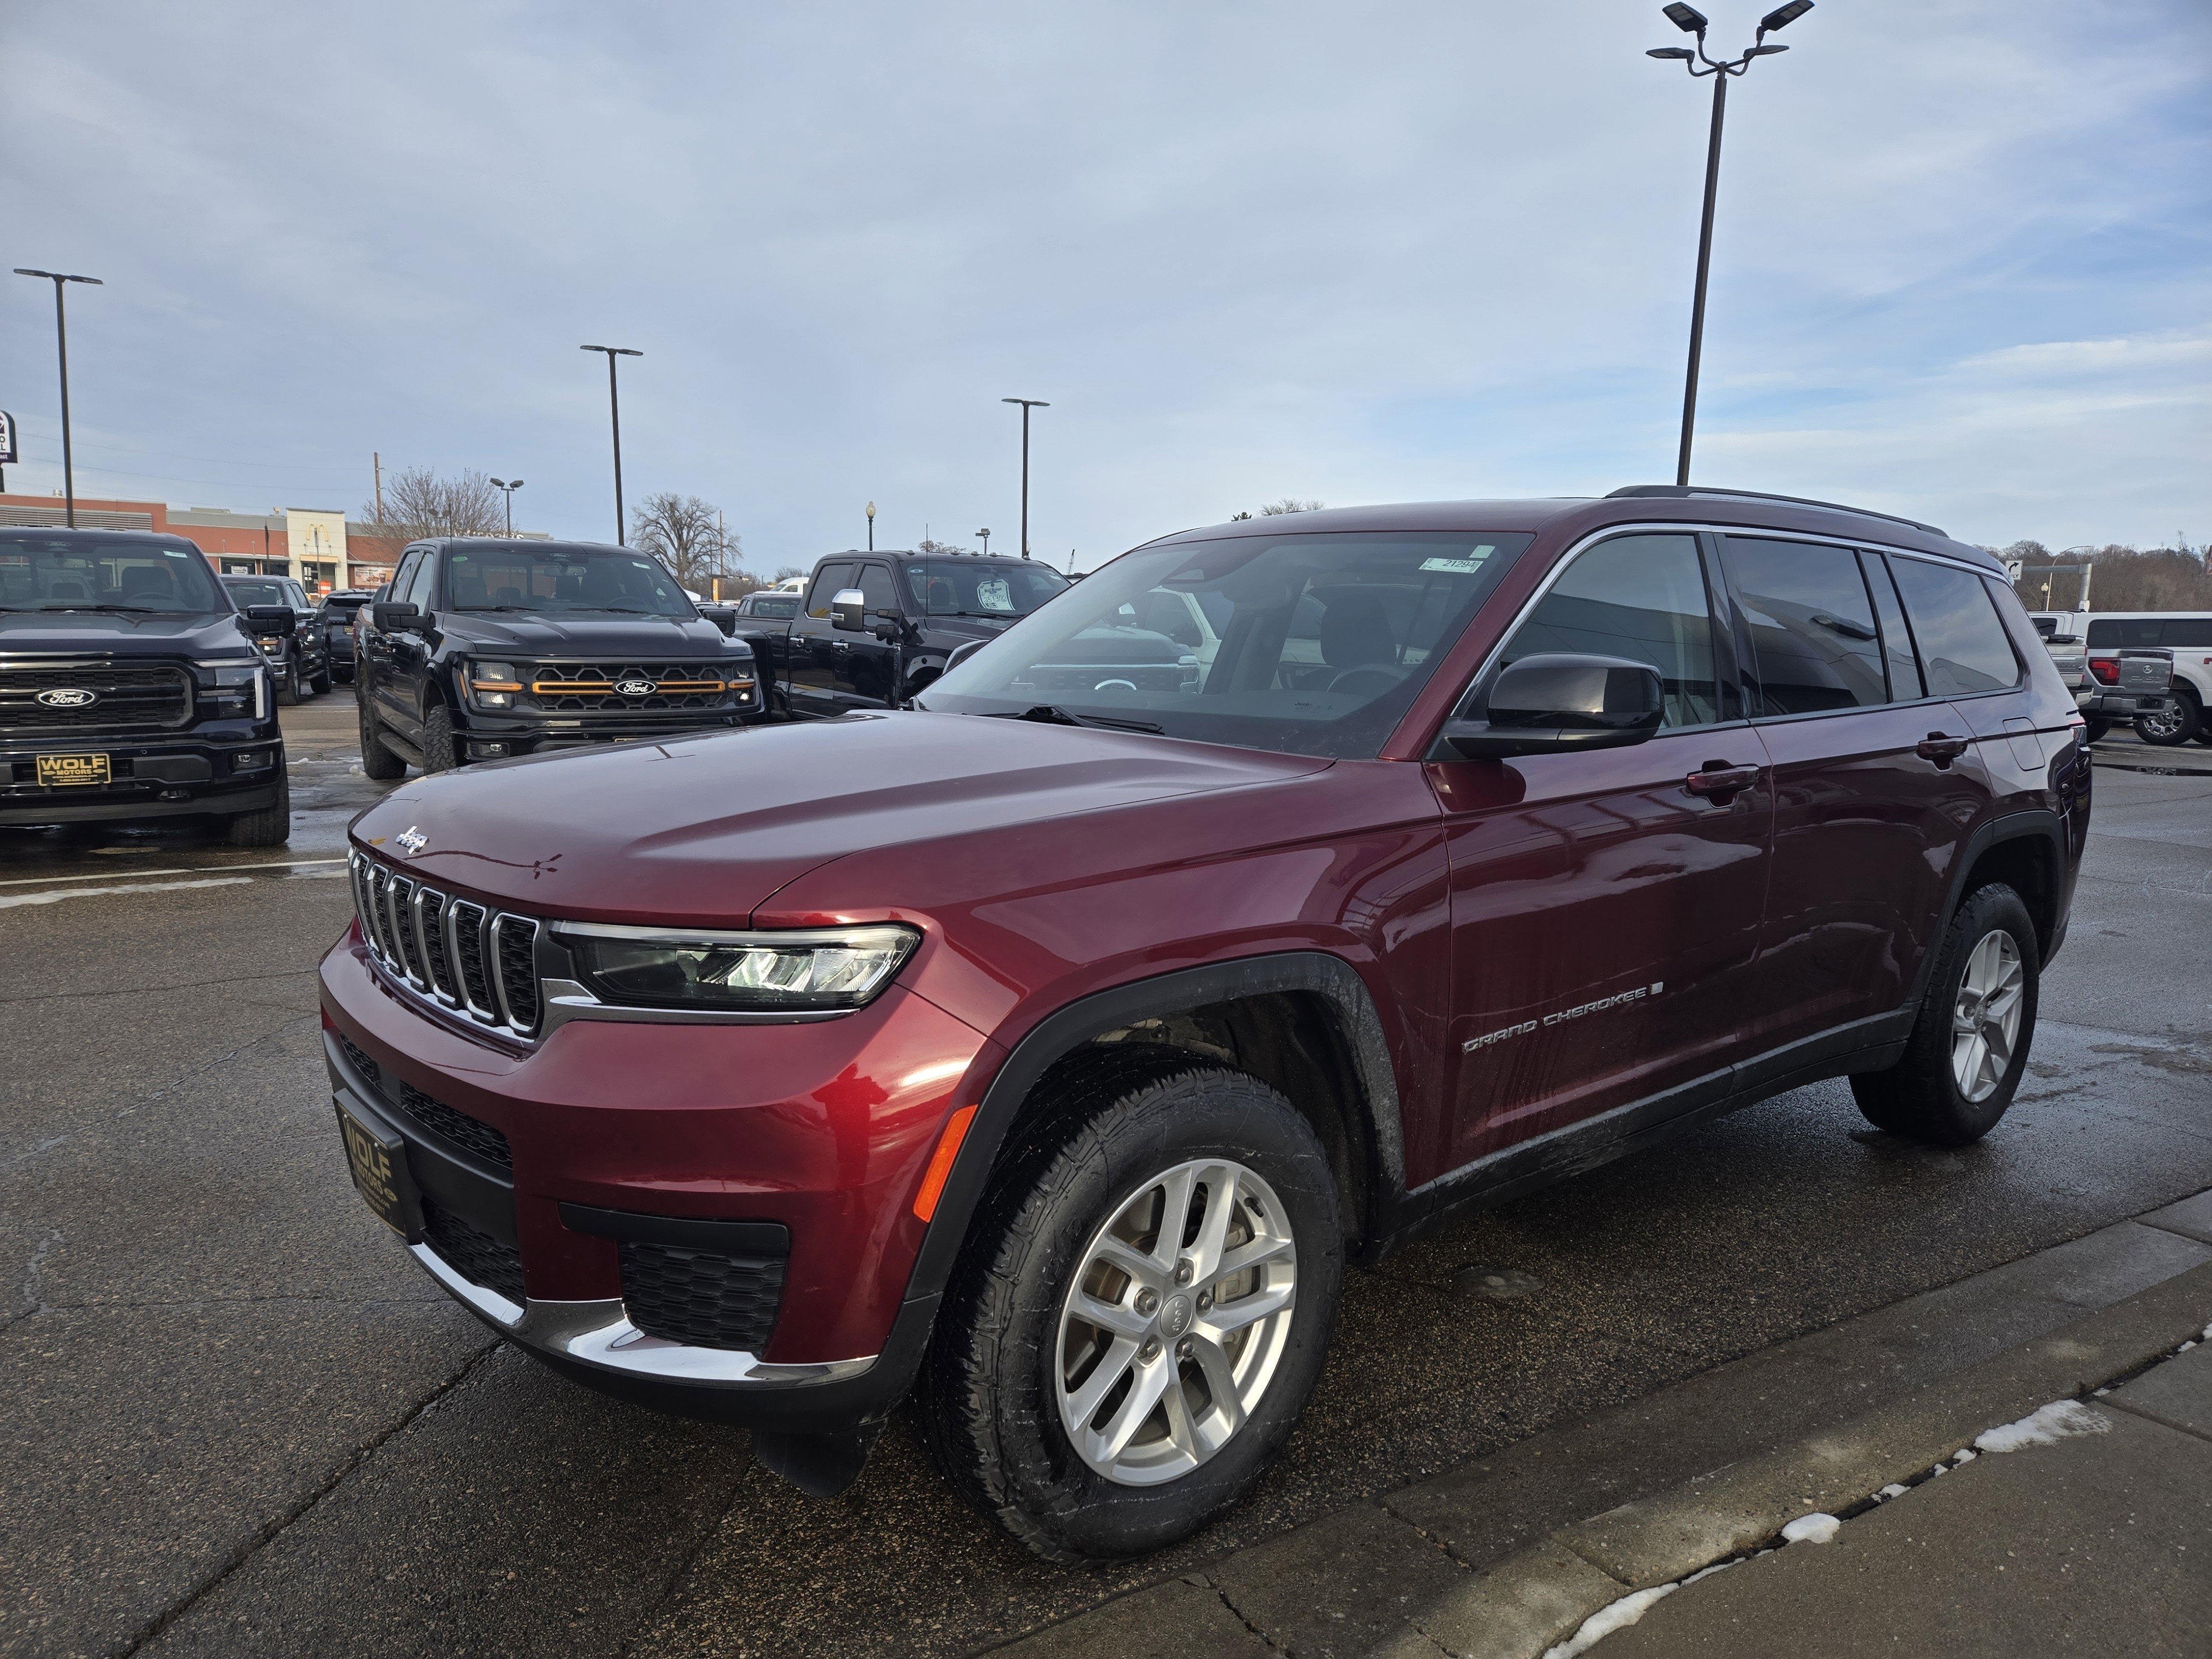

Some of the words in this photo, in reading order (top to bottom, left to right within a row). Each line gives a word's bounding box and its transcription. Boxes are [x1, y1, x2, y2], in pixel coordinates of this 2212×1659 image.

[1442, 560, 1476, 568] 21294
[49, 691, 85, 704] Ford
[623, 682, 649, 692] Ford
[40, 758, 105, 770] WOLF
[395, 826, 429, 855] Jeep
[1463, 1020, 1538, 1053] GRAND
[1543, 987, 1647, 1027] CHEROKEE
[346, 1121, 392, 1182] WOLF
[355, 1158, 383, 1196] MOTORS
[1171, 1300, 1185, 1332] Jeep
